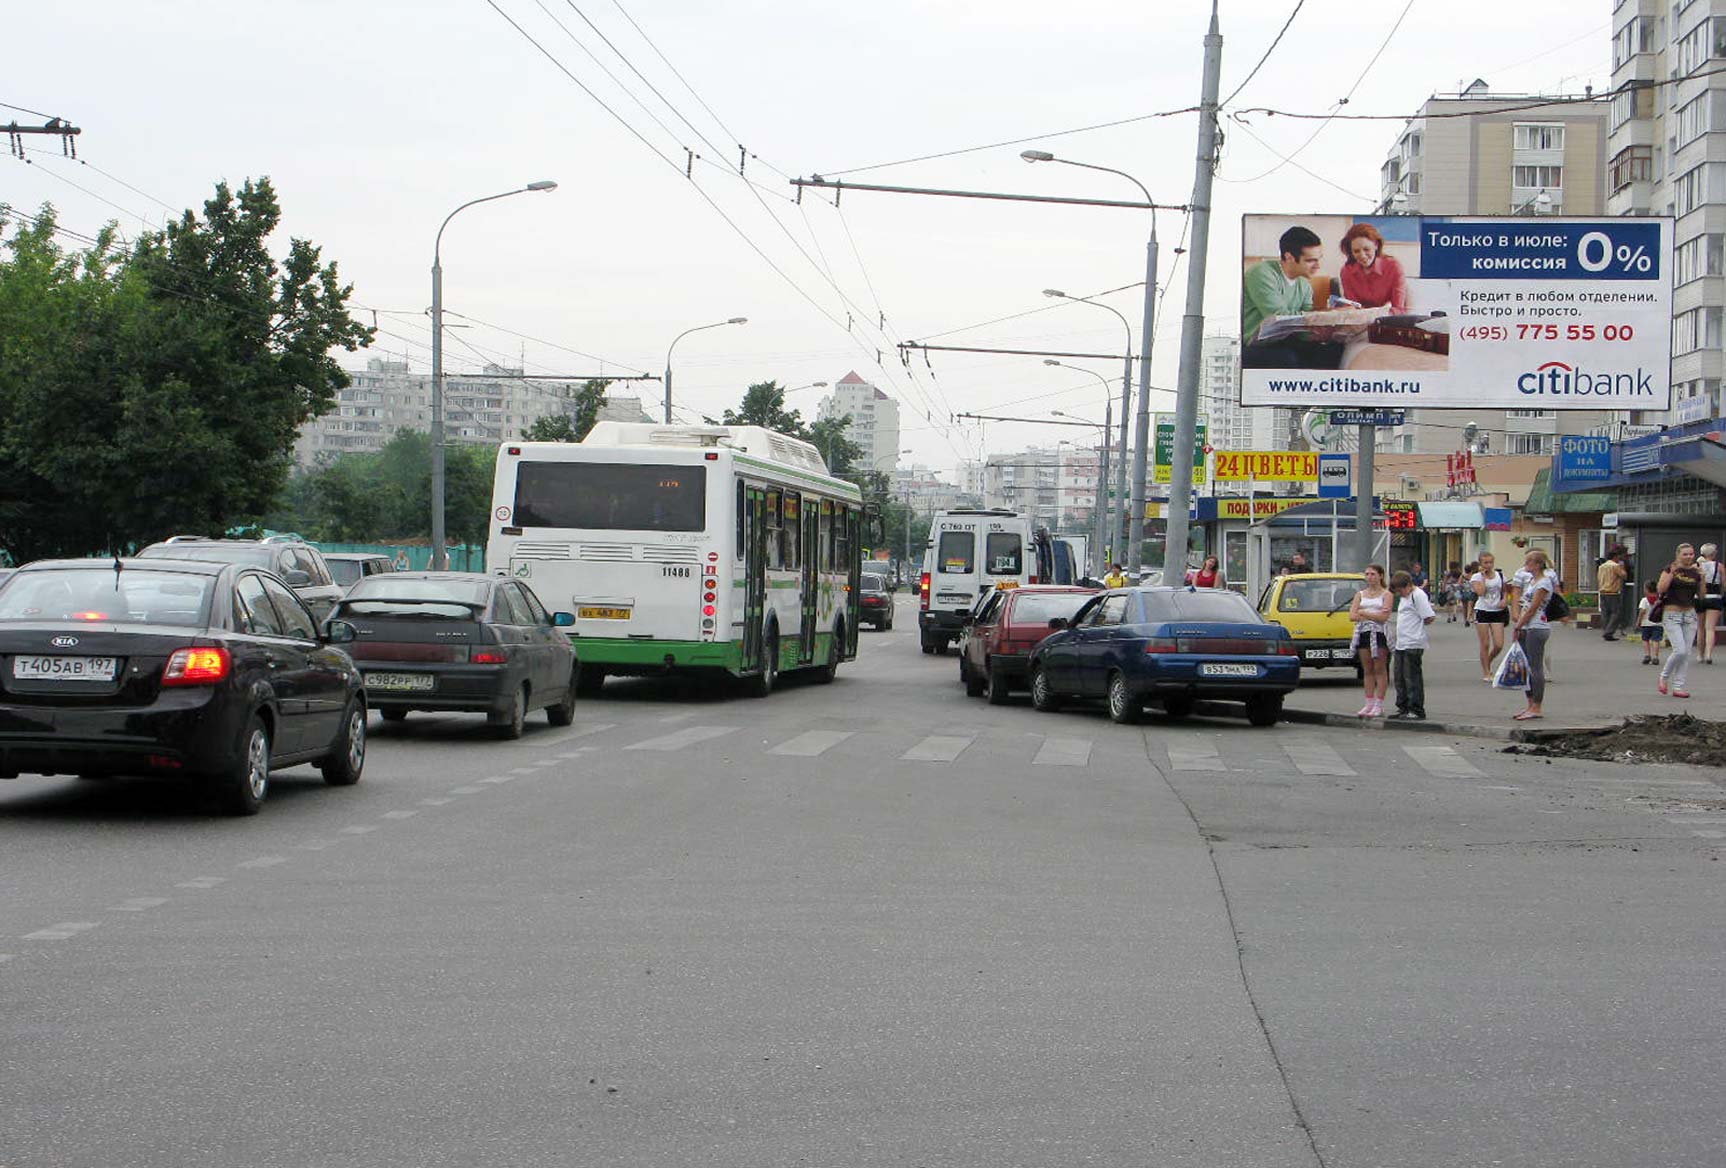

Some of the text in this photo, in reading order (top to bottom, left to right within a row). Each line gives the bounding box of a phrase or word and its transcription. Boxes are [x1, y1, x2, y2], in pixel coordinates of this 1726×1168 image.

[1427, 231, 1568, 248] Только в июле:
[1576, 231, 1652, 272] 0%
[1472, 257, 1567, 270] комиссия
[1460, 290, 1658, 304] Кредит в любом отделении.
[1460, 305, 1582, 319] Быстро и просто.
[1459, 324, 1634, 342] (495) 775 55 00
[1269, 377, 1422, 396] www.citibank.ru
[1517, 362, 1653, 397] citibank
[1563, 438, 1609, 455] ФОТО
[662, 566, 690, 578] 11488
[20, 658, 112, 674] Т405АВ 197
